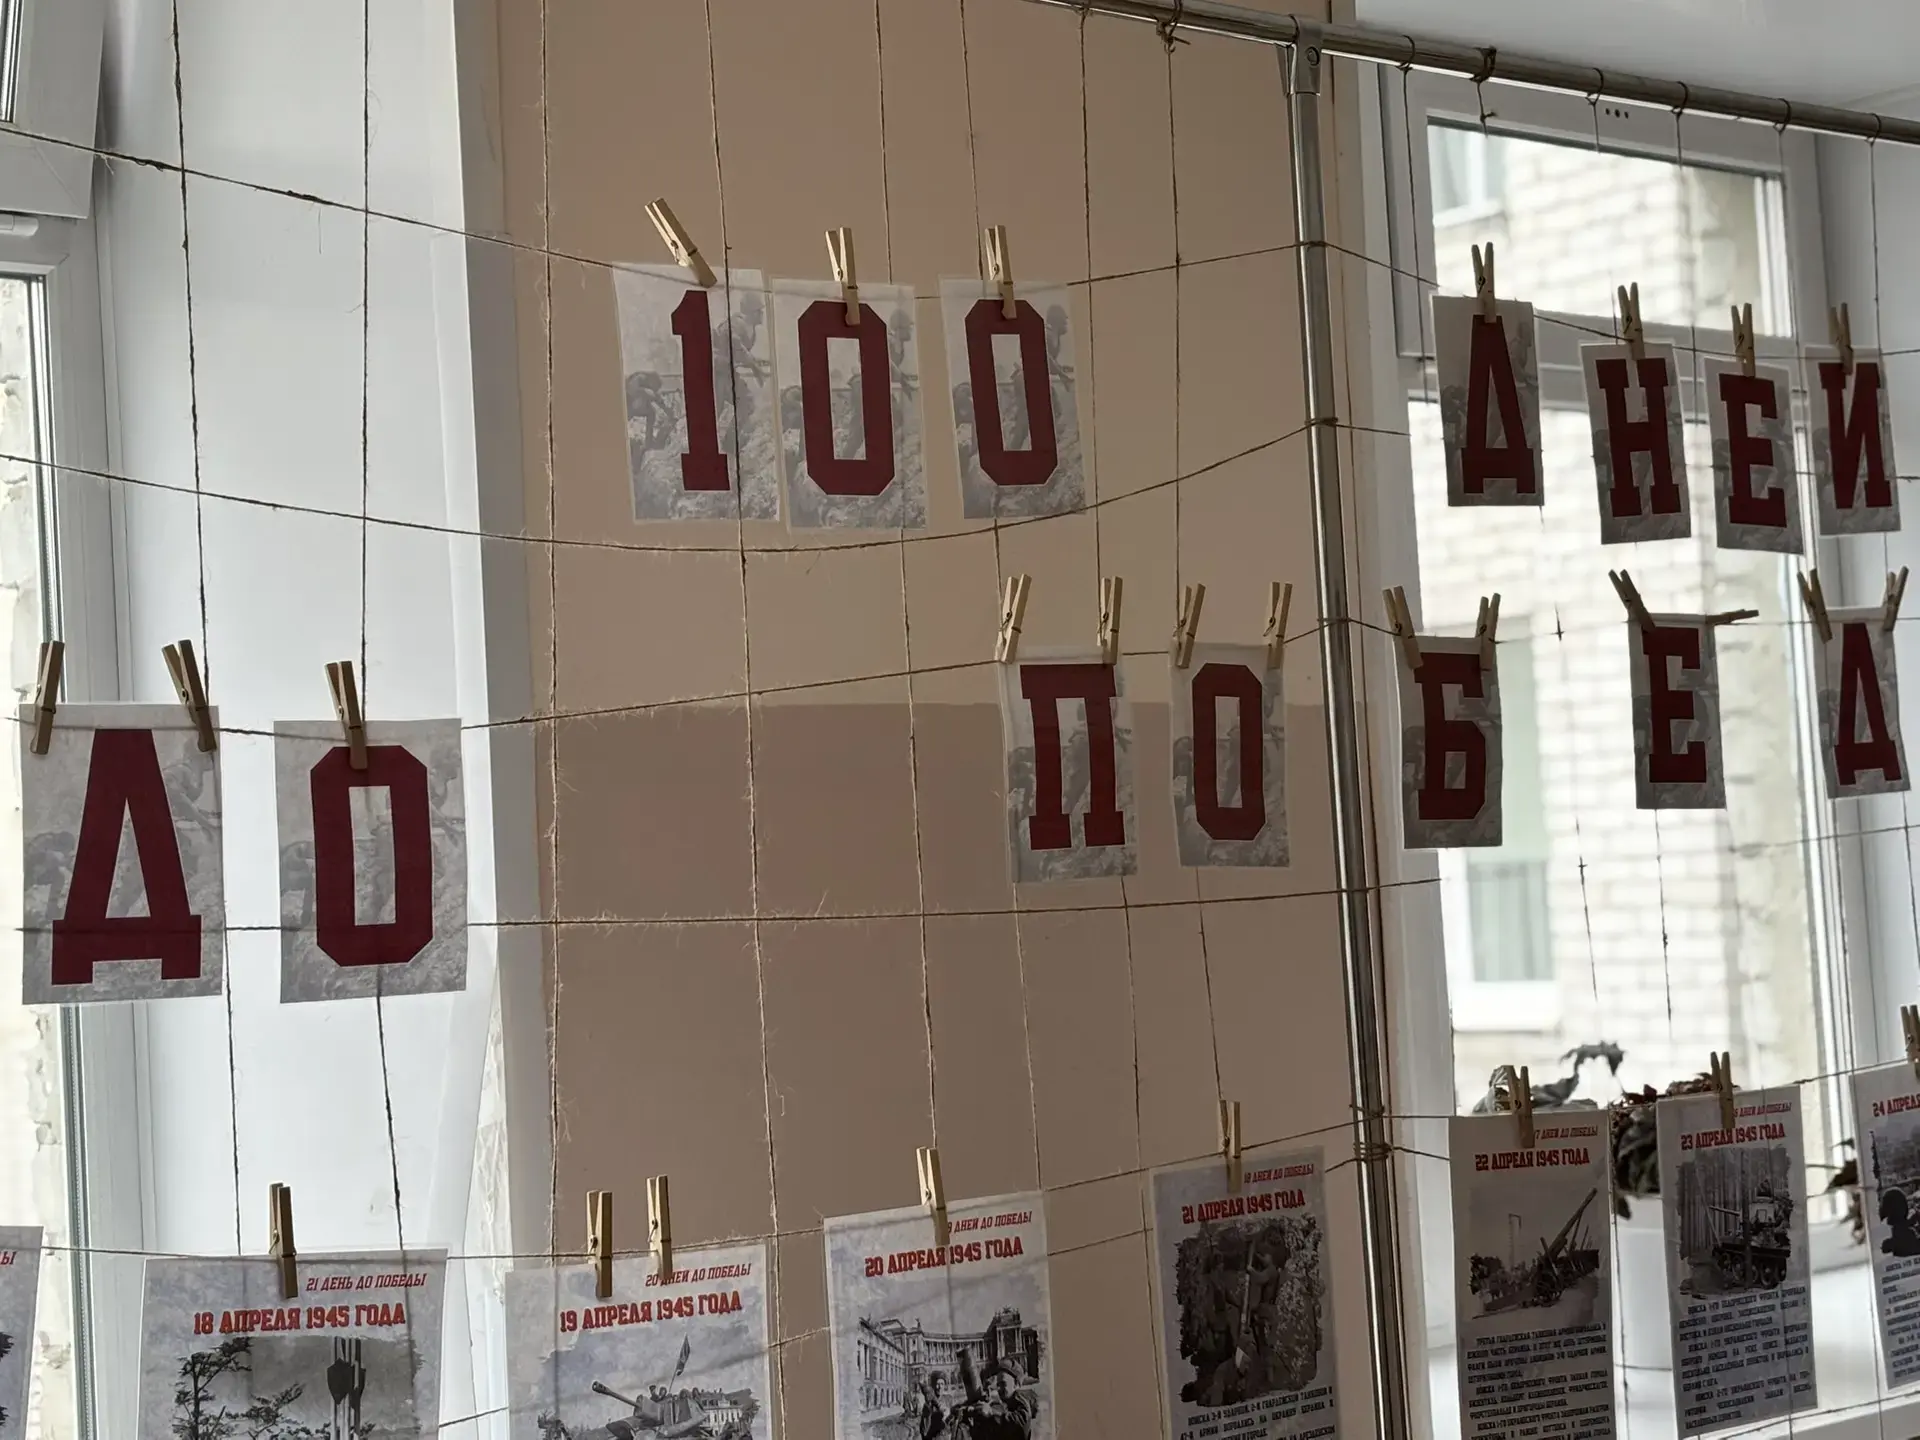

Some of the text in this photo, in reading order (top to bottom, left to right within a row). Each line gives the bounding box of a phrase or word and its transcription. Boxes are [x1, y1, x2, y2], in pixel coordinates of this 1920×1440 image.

[671, 290, 1058, 496] 100
[52, 729, 434, 985] ДО
[1872, 1102, 1885, 1117] 24
[1681, 1123, 1785, 1150] 23 АПРЕЛЯ 1945 ГОДА
[1475, 1147, 1590, 1171] 22 АПРЕЛЯ 1945 ГОДА
[1273, 1168, 1283, 1180] ДО
[1182, 1189, 1306, 1224] 21 АПРЕЛЯ 1945 ГОДА
[981, 1216, 993, 1230] ДО
[994, 1211, 1032, 1227] ПОБЕДЫ
[864, 1236, 1024, 1277] 20 АПРЕЛЯ 1945 ГОДА
[306, 1272, 427, 1291] 21 ДЕНЬ ДО ПОБЕДЫ
[645, 1274, 659, 1287] 20
[692, 1268, 706, 1283] ДО
[707, 1263, 751, 1280] ПОБЕДЫ
[194, 1303, 406, 1334] 18 АПРЕЛЯ 1945 ГОДА
[560, 1290, 742, 1332] 19 АПРЕЛЯ 1945 ГОДА
